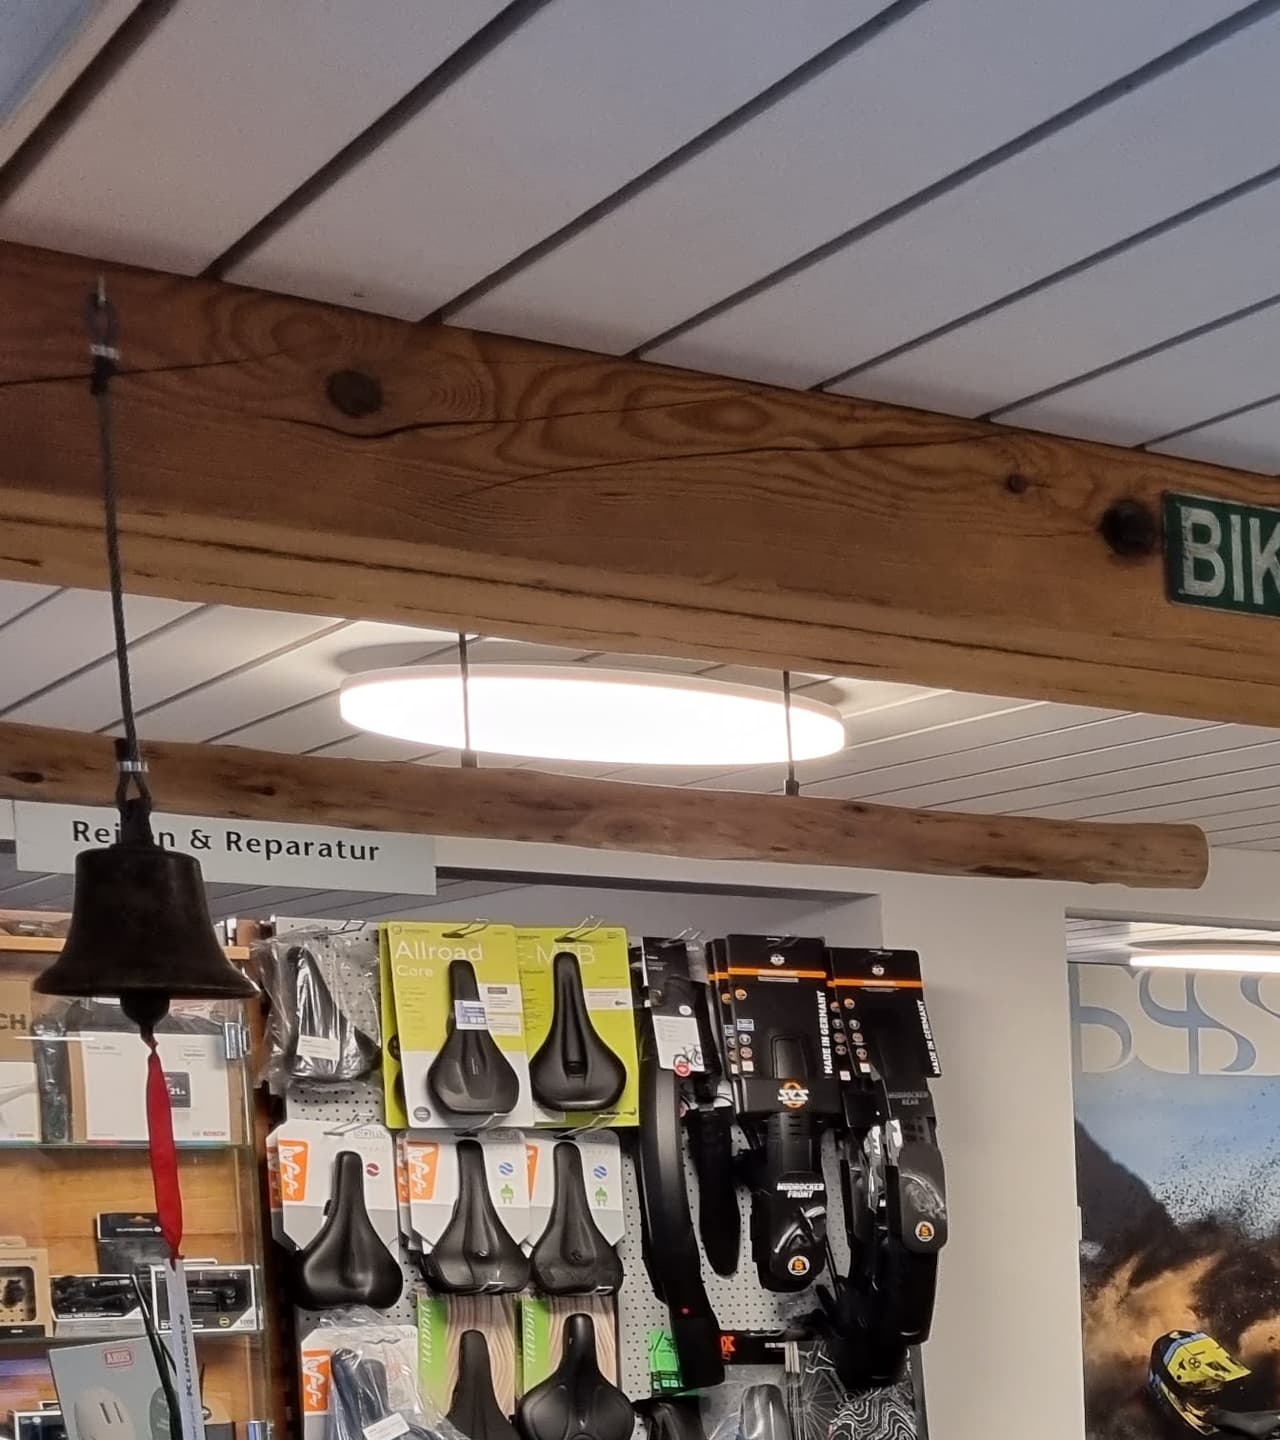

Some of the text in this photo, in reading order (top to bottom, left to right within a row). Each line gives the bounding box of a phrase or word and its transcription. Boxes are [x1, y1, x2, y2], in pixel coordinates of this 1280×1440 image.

[72, 820, 380, 861] Rein & Reparatur
[394, 940, 484, 961] Allroad
[395, 964, 434, 978] Core
[822, 1048, 834, 1075] MADE
[786, 1190, 814, 1199] FRONT
[176, 1312, 196, 1398] KLINGELN
